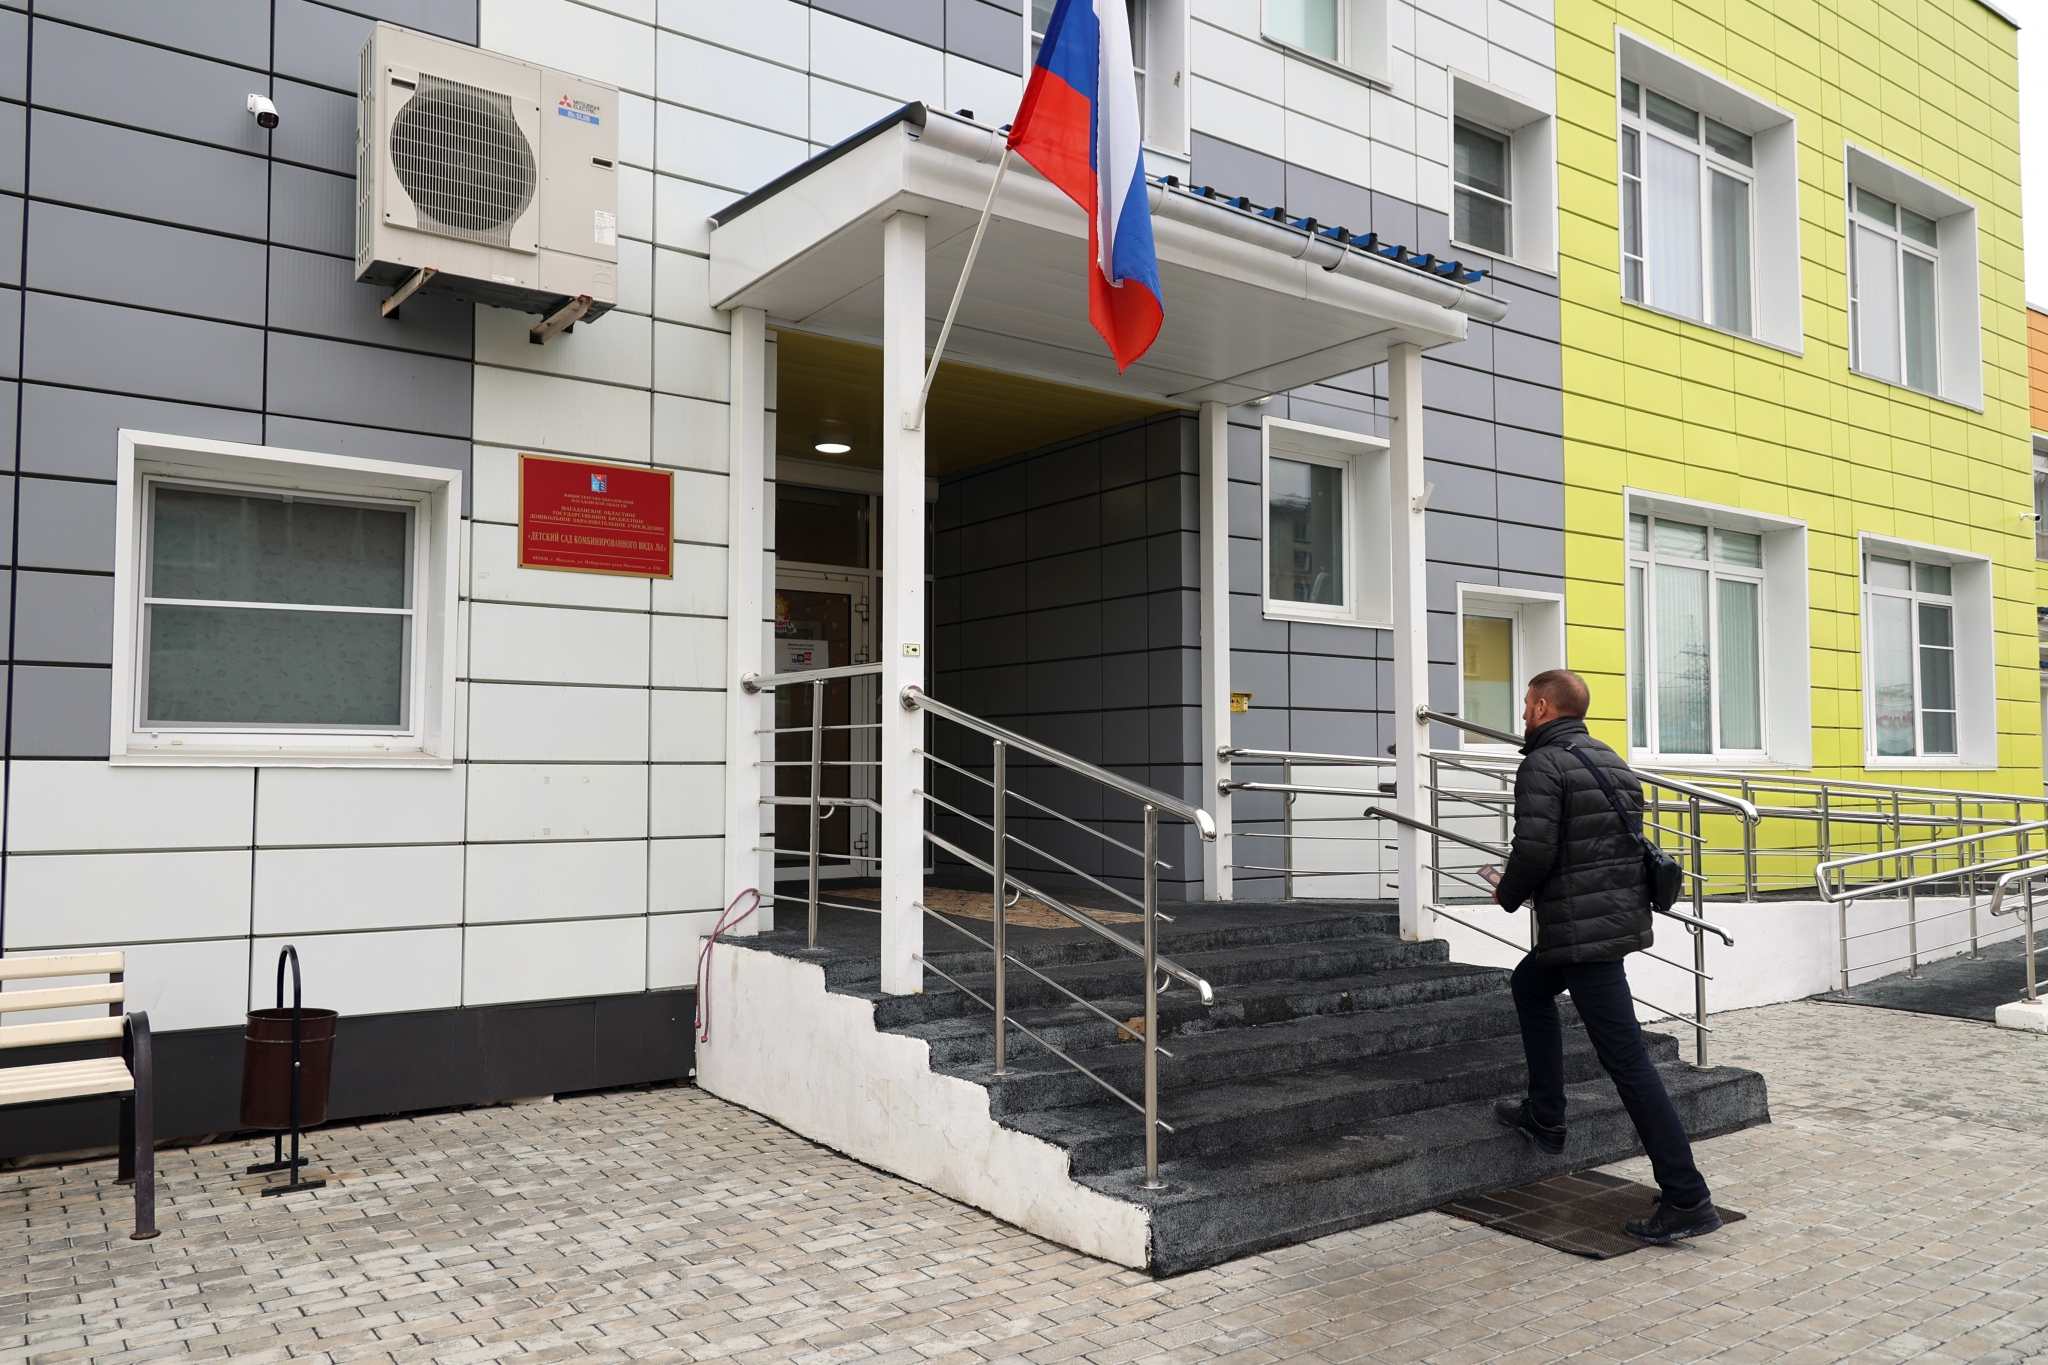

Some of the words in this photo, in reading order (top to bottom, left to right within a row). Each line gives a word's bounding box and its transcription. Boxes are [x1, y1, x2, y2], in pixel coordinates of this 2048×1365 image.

[573, 99, 600, 111] MITSUBISHI
[573, 104, 596, 114] ELECTRIC
[564, 493, 601, 501] МИНИСТЕРСТВО
[561, 506, 603, 515] МАГАДАНСКОЕ
[529, 513, 571, 522] ДОШКОЛЬНОЕ
[572, 518, 627, 528] ОБРАЗОВАТЕЛЬНОЕ
[627, 523, 665, 531] УЧРЕЖДЕНИЕ
[552, 510, 607, 520] ГОСУДАРСТВЕННОЕ
[608, 516, 644, 524] БЮДЖЕТНОЕ
[560, 534, 573, 544] САД
[573, 535, 637, 549] КОМБИНИРОВАННОГО
[638, 541, 654, 551] ВИДА
